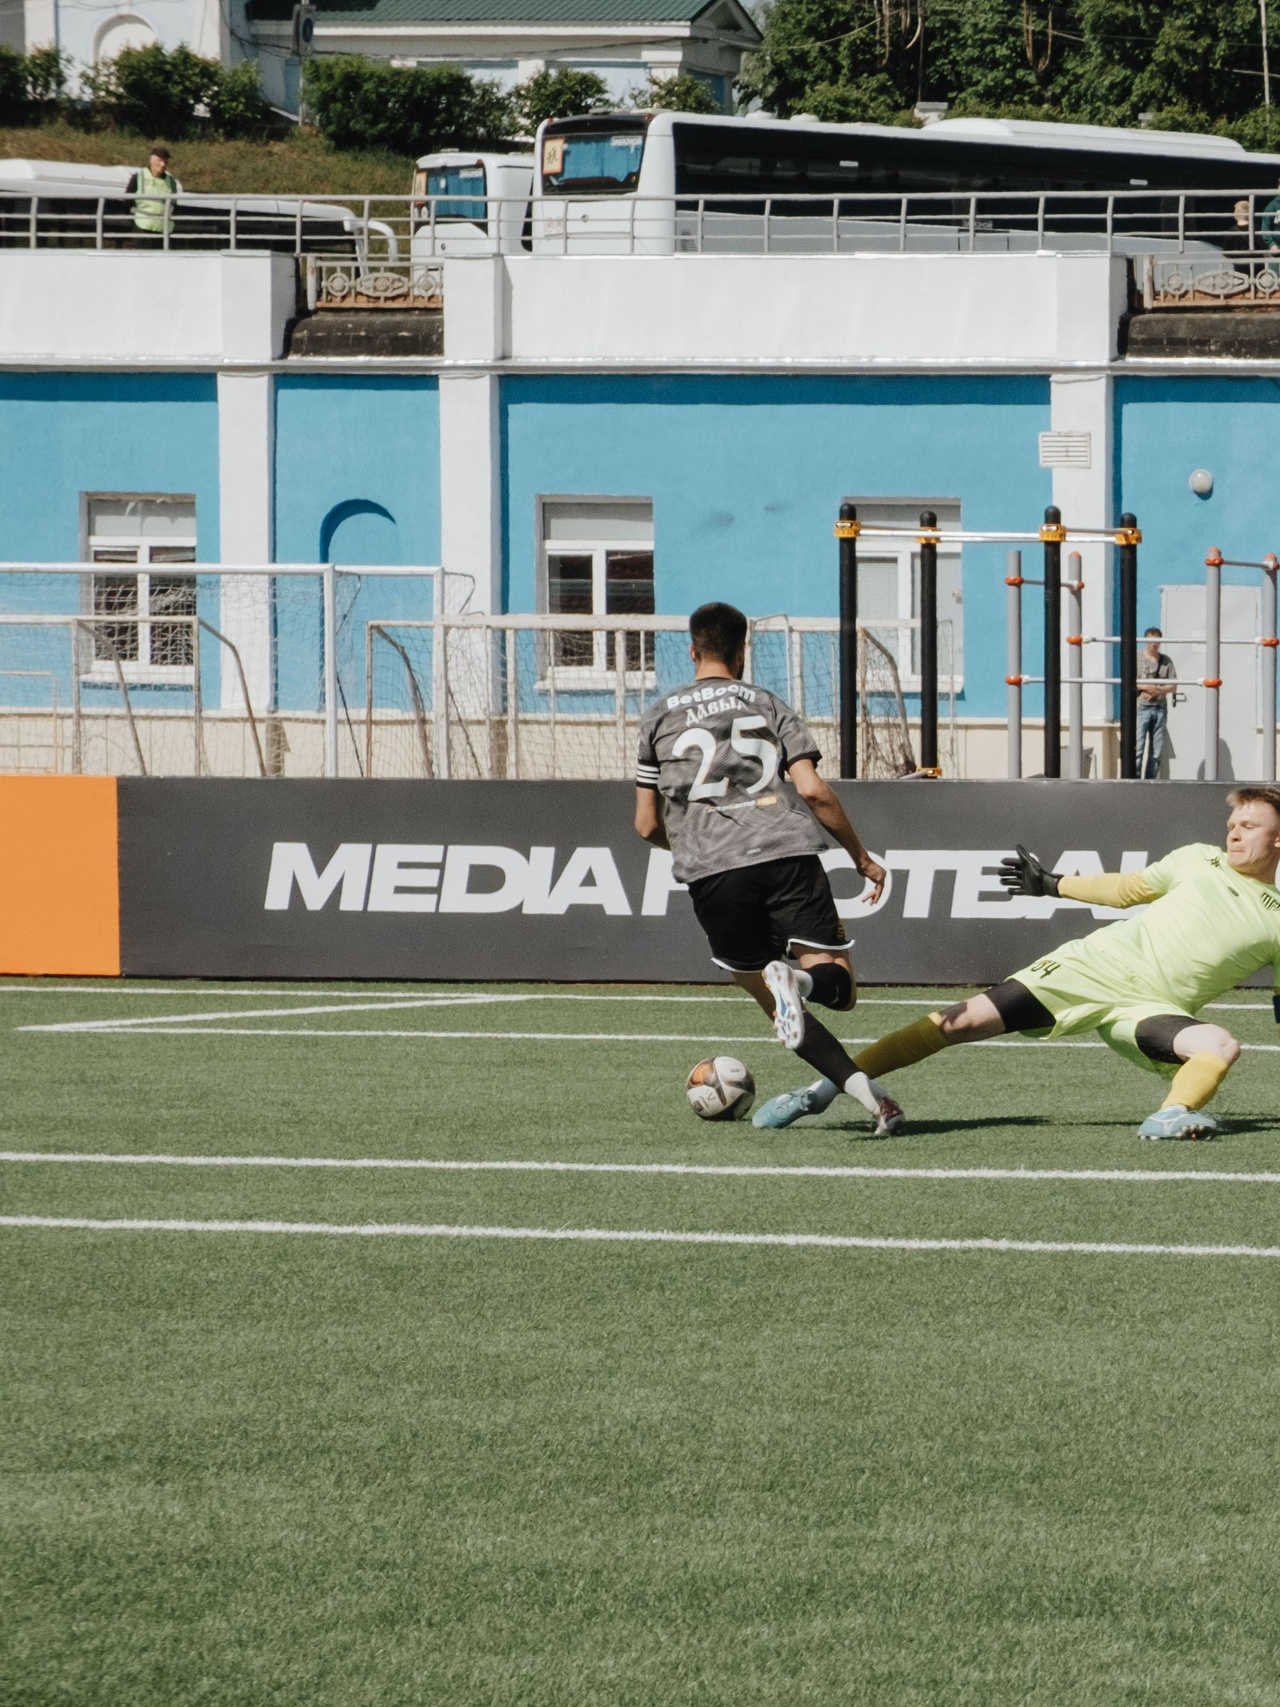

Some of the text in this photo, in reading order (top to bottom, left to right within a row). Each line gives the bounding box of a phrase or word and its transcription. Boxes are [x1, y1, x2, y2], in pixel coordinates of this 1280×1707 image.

[666, 684, 756, 710] BetBoom
[672, 715, 778, 801] 25
[264, 842, 632, 916] MEDIA
